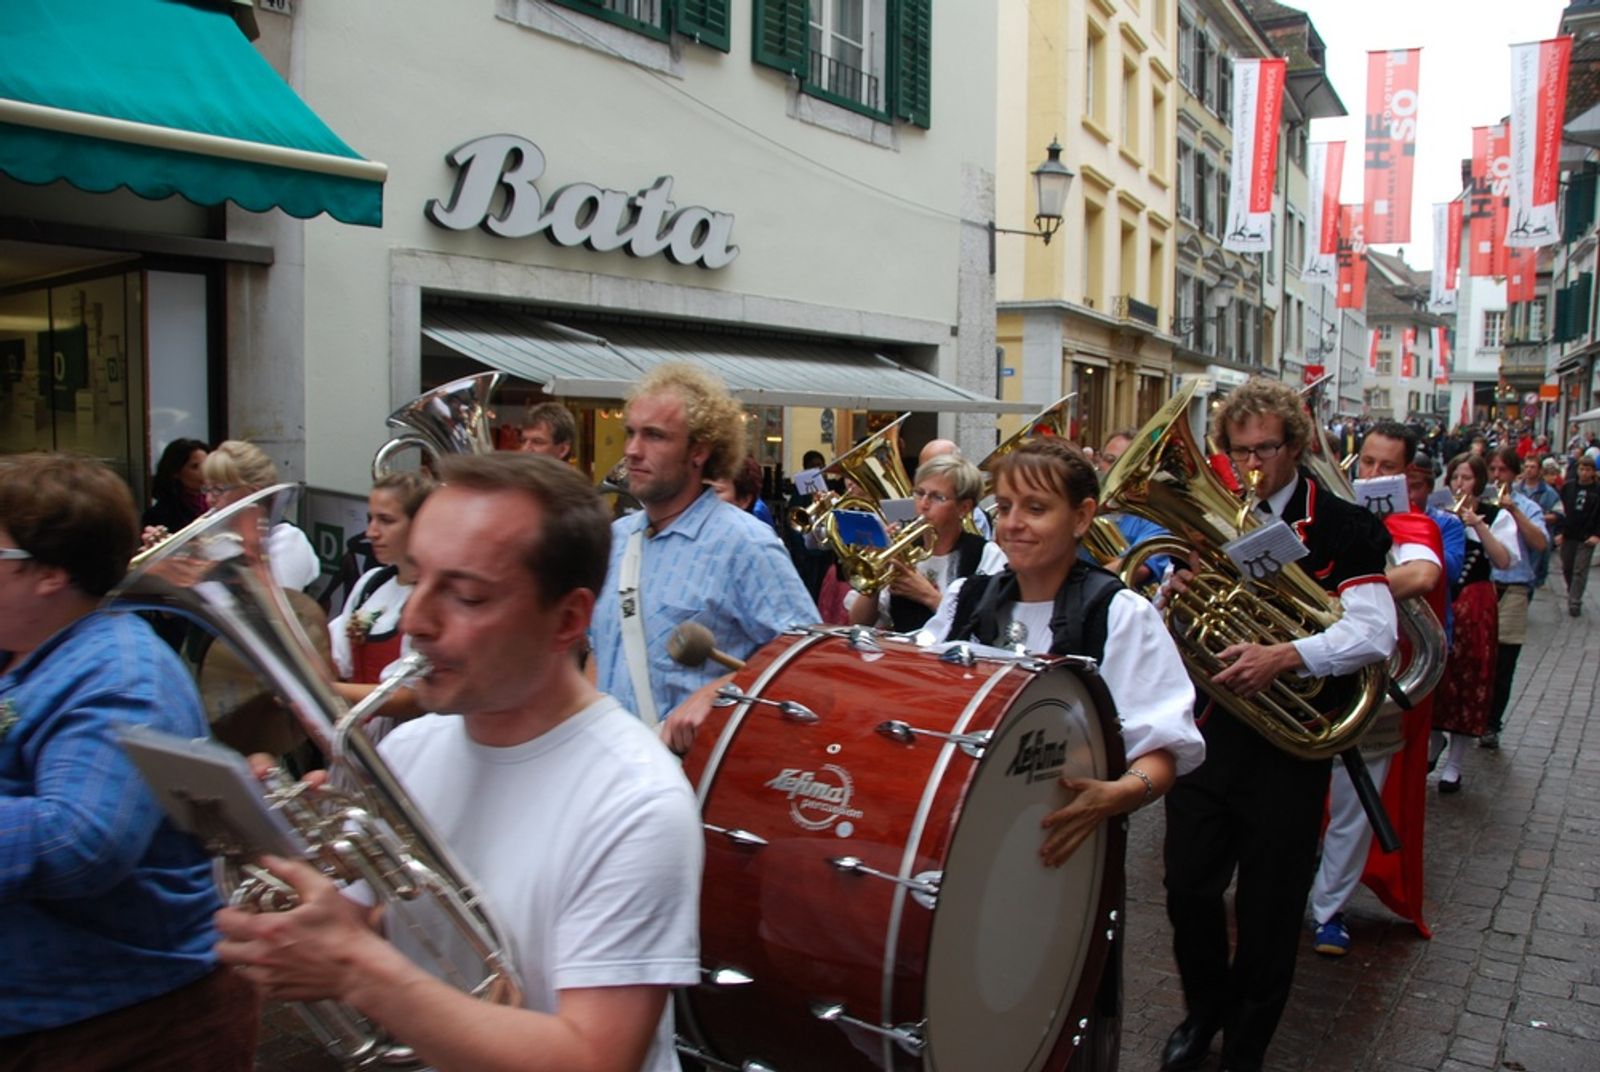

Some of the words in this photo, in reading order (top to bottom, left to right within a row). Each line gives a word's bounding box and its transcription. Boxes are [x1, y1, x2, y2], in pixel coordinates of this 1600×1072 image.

[1365, 113, 1391, 169] HE
[1391, 89, 1418, 142] SO
[424, 133, 741, 270] Bata
[320, 530, 338, 561] D
